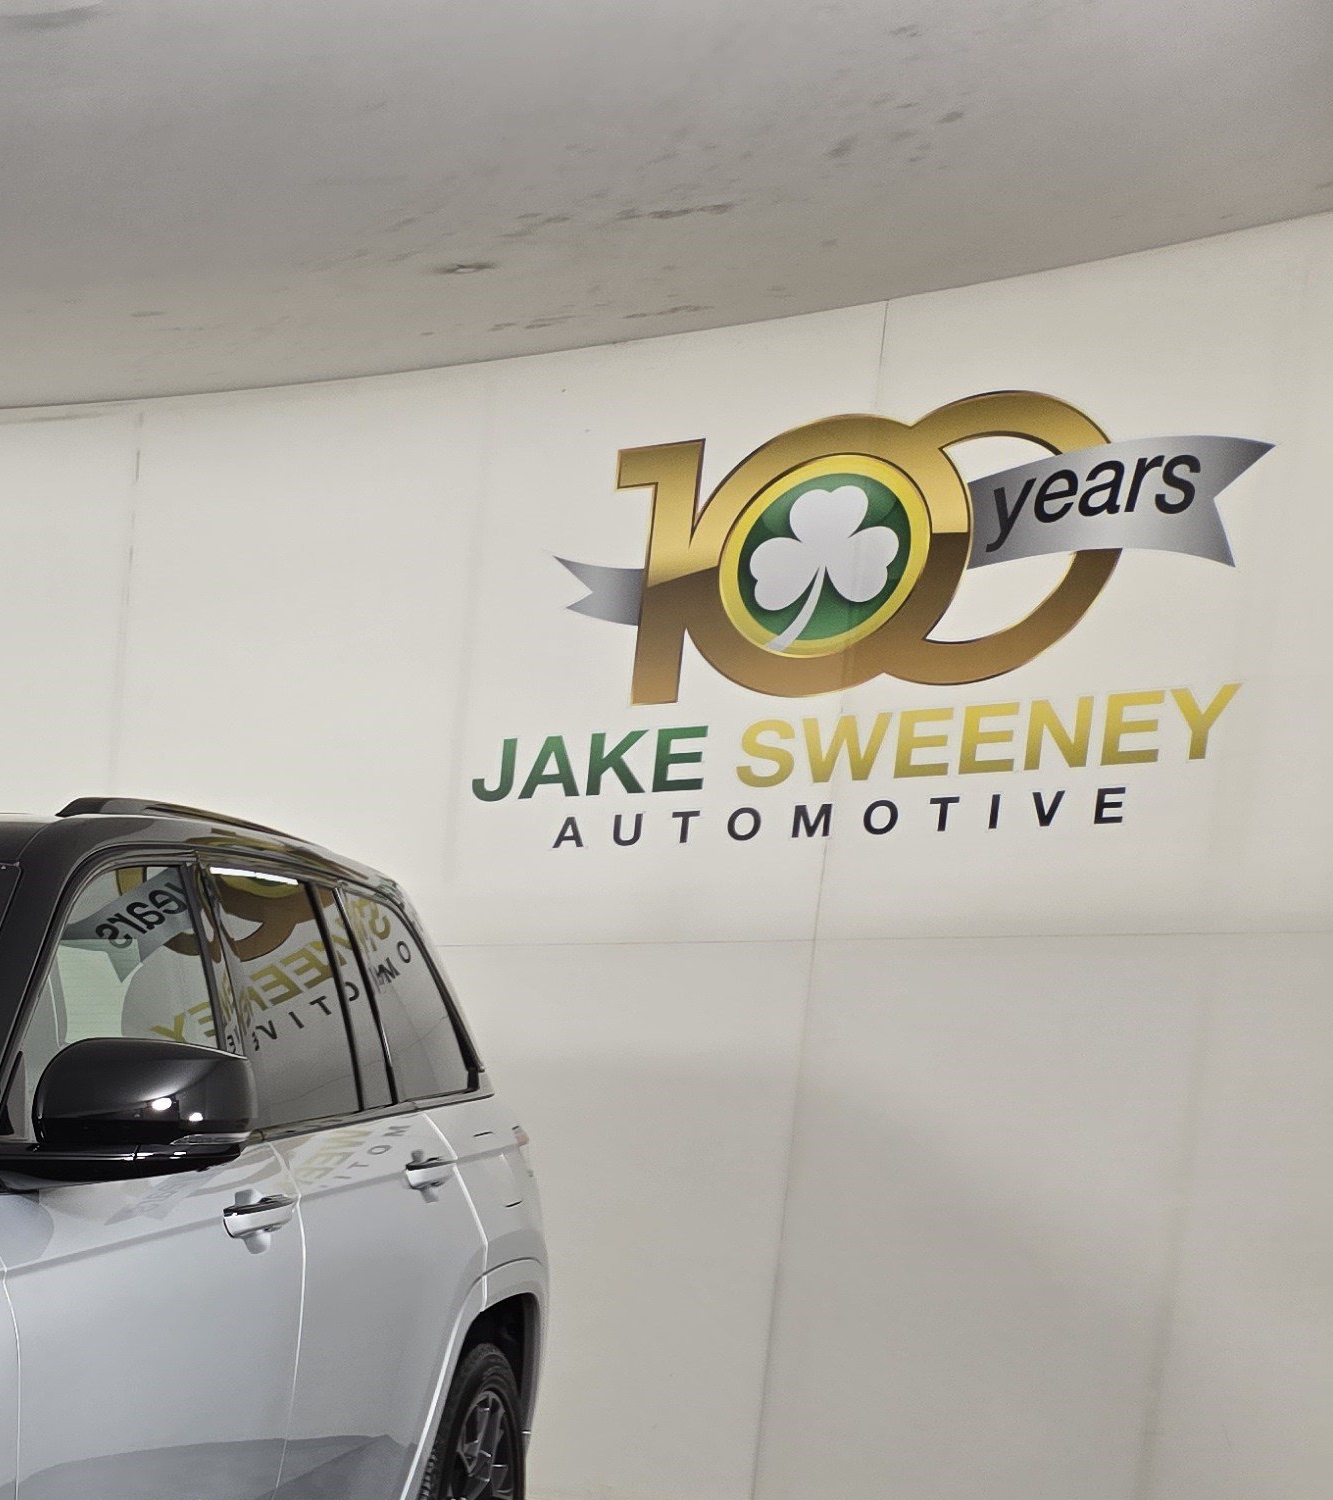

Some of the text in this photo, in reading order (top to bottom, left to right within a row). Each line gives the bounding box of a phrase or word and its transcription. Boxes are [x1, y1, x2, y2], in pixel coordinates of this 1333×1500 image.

[616, 390, 1201, 705] 100 years
[472, 683, 1242, 802] JAKE SWEENEY
[552, 787, 1126, 849] AUTOMOTIVE
